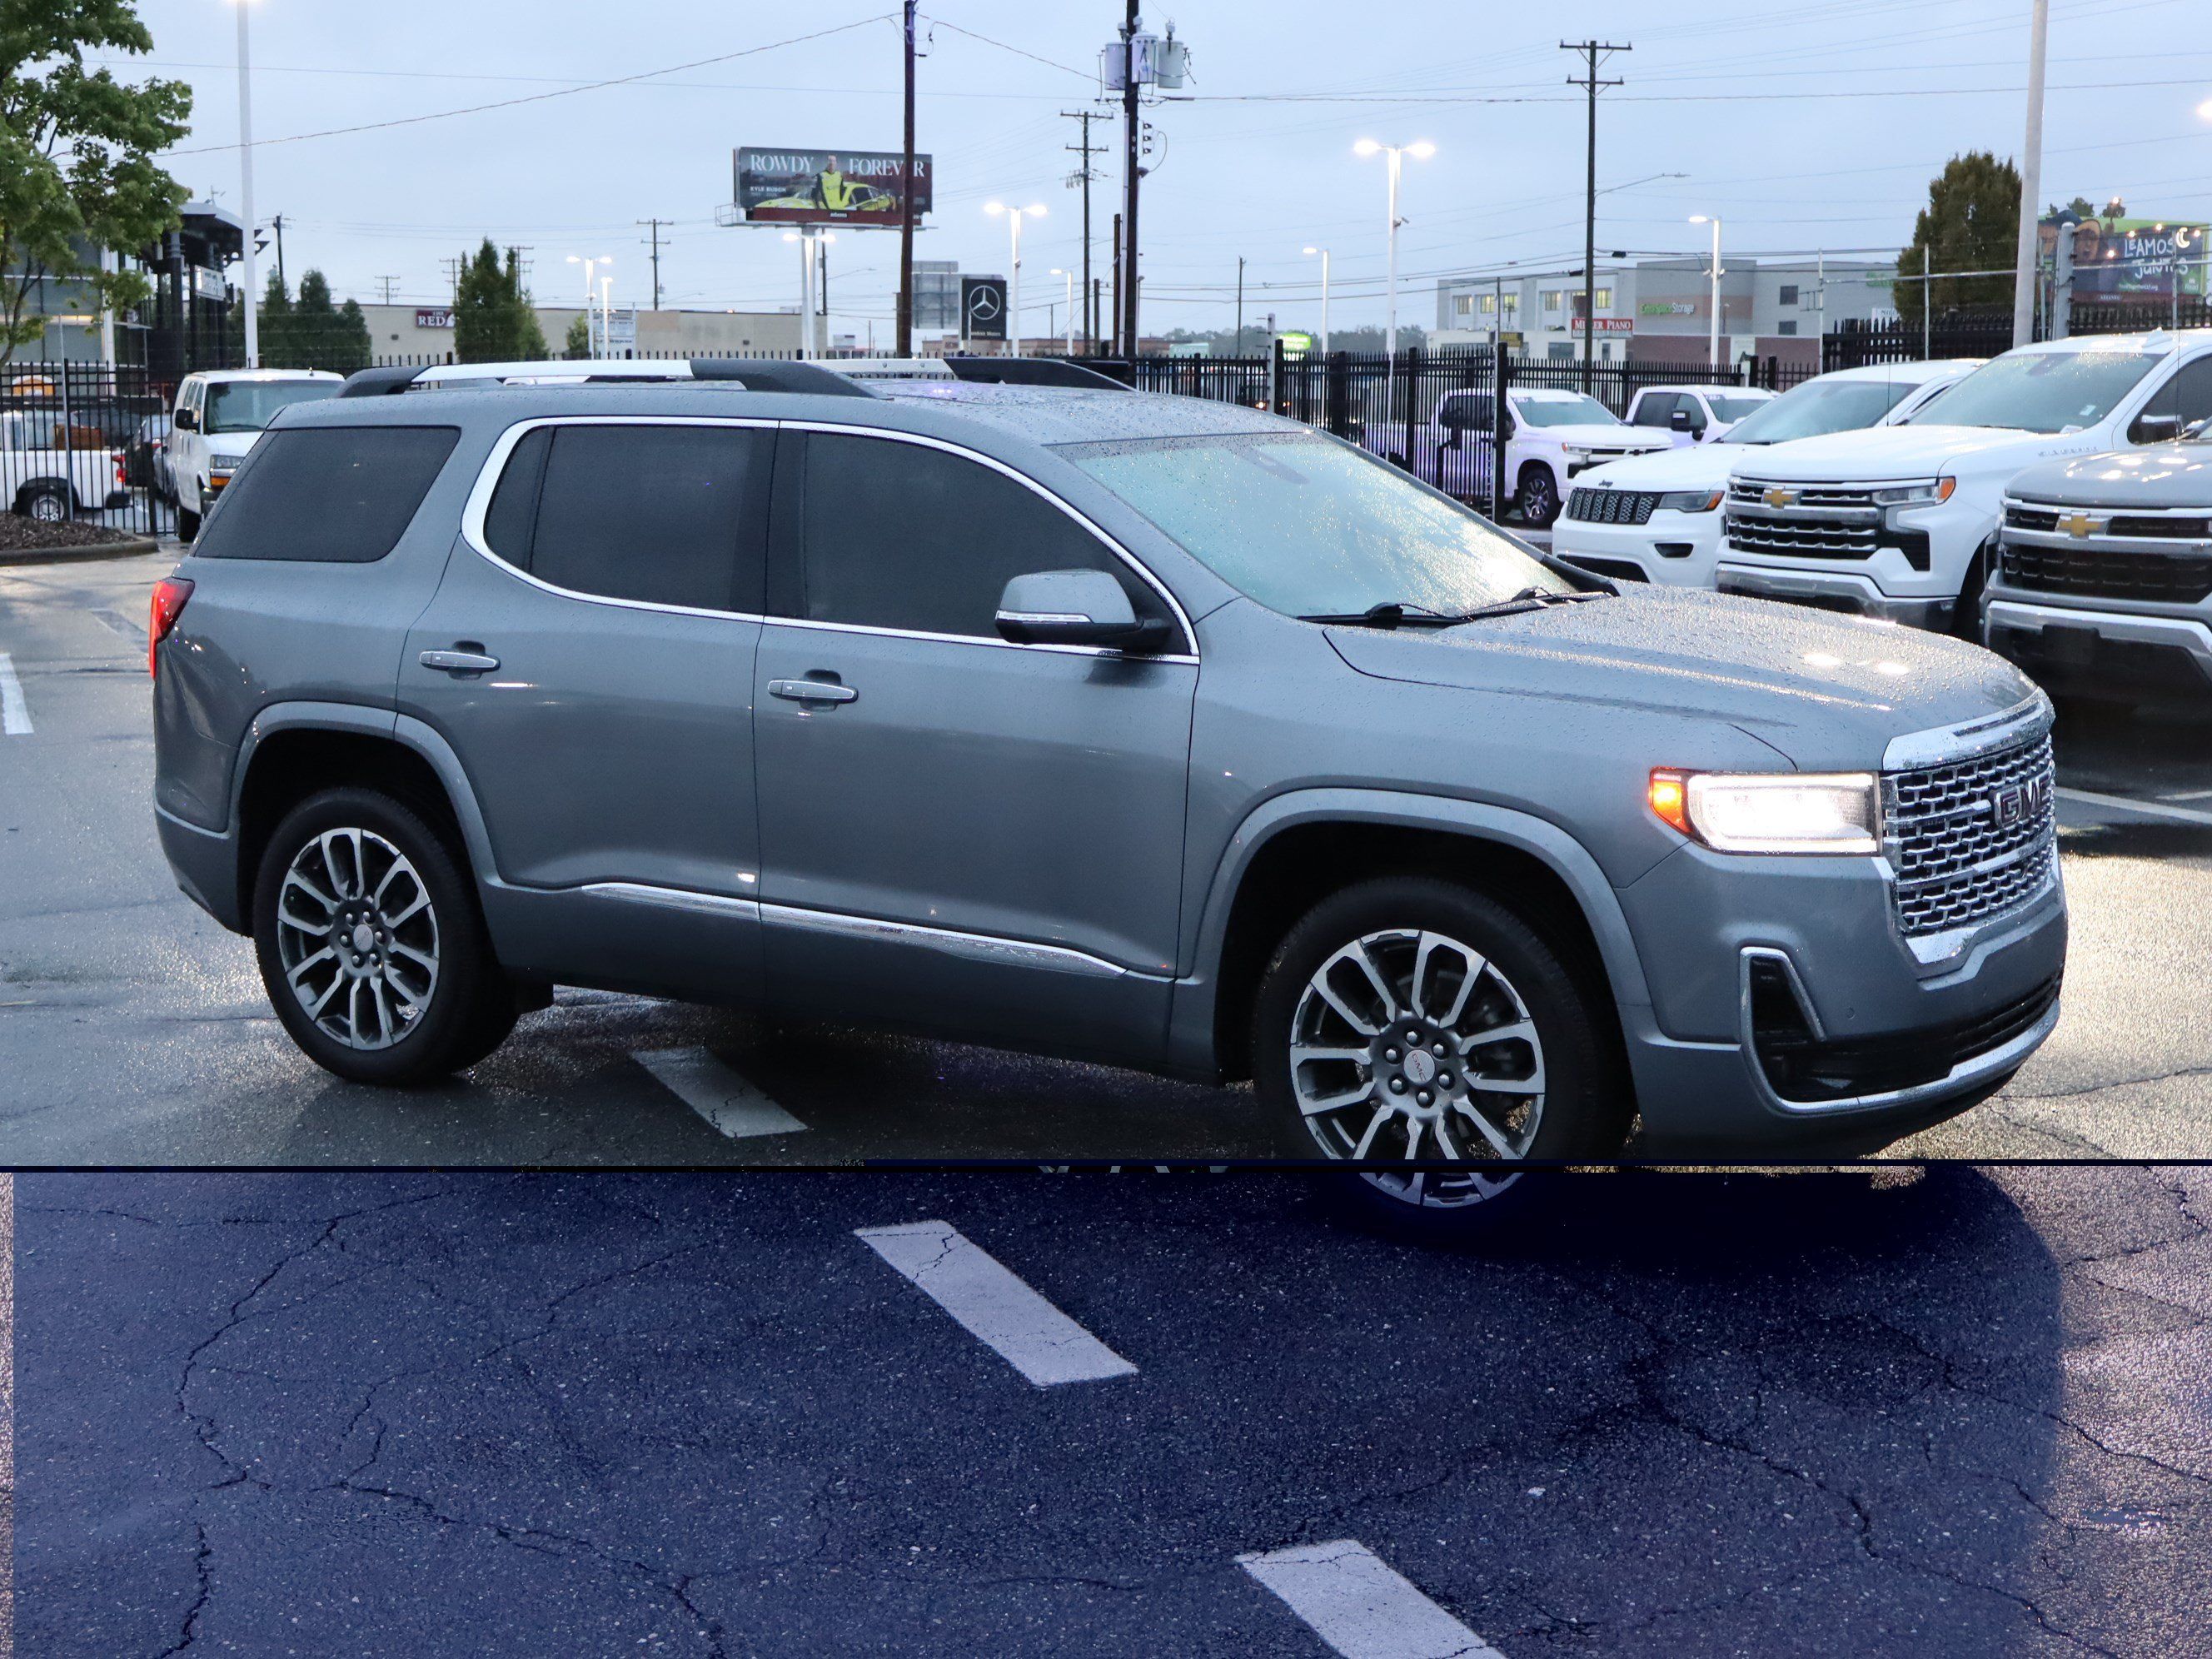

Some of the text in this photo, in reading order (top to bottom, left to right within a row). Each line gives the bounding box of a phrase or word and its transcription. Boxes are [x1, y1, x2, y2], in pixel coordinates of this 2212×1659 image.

[750, 154, 925, 177] ROWDY FOREVR
[418, 316, 446, 326] RED
[1574, 320, 1632, 330] MIER PIANO
[1994, 767, 2054, 828] GMC
[1412, 1053, 1427, 1082] GMC
